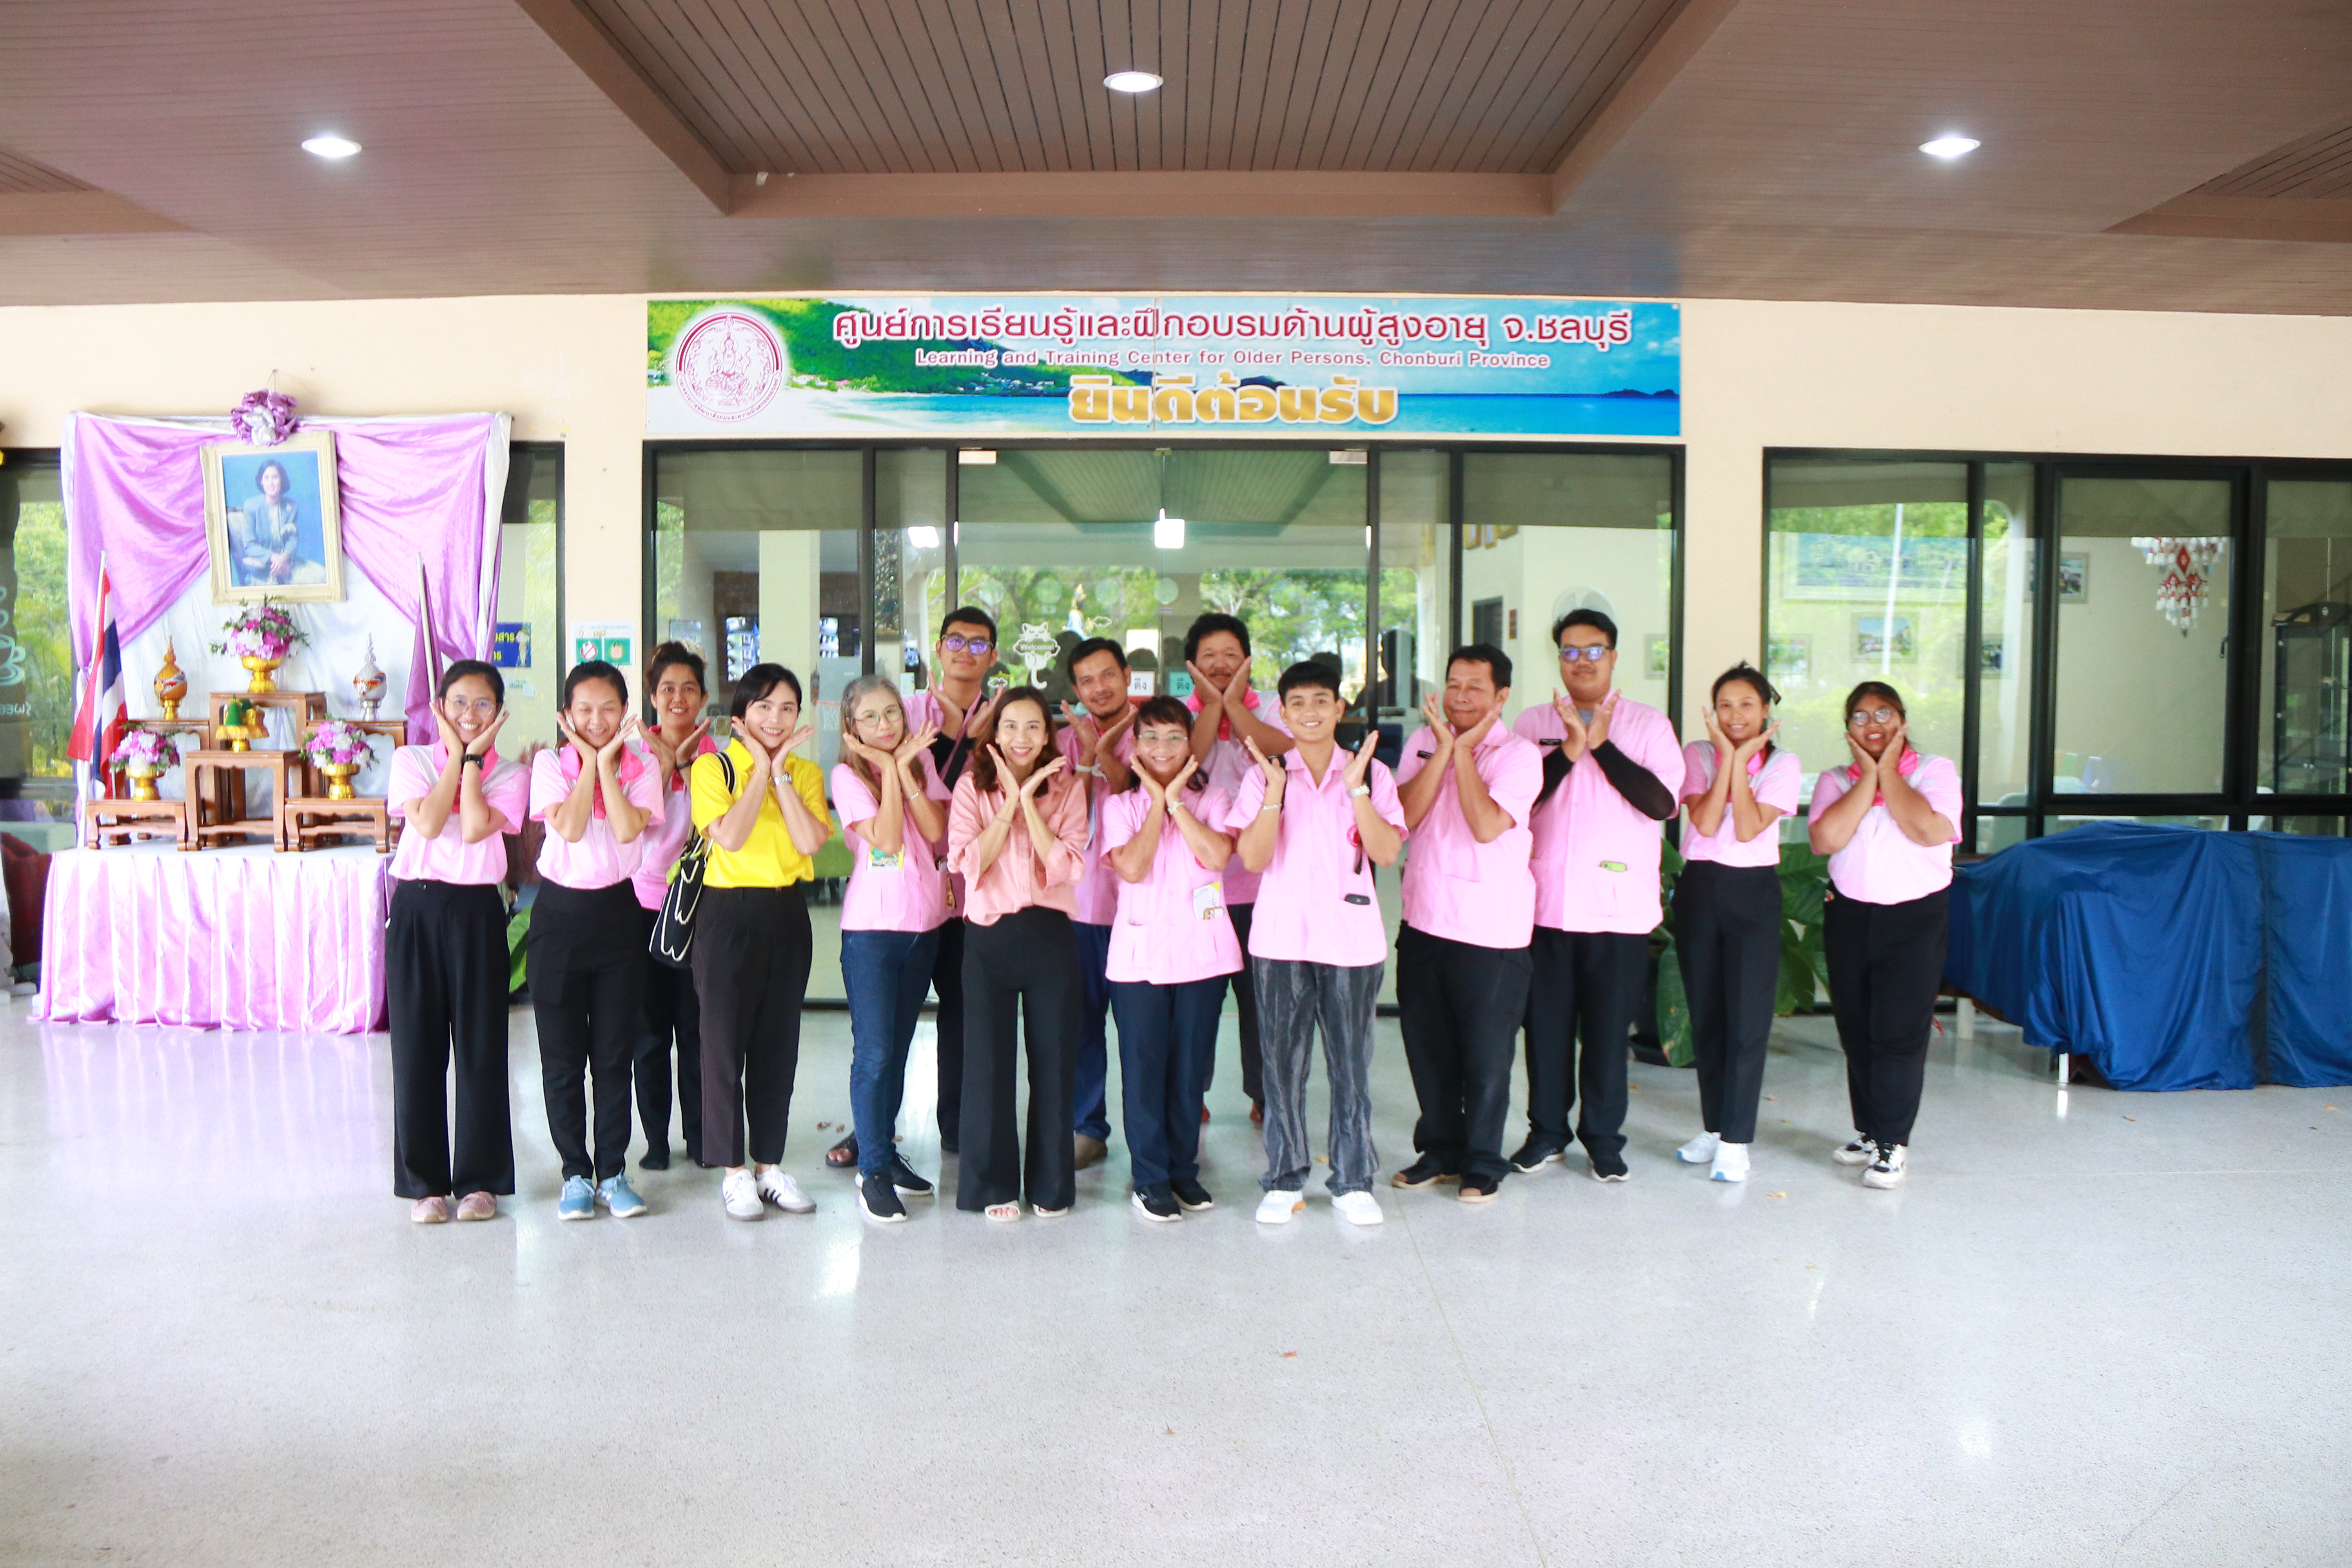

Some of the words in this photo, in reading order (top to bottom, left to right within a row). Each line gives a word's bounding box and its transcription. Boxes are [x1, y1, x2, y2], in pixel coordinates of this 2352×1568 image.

[837, 307, 1485, 347] ศูนย์การเรียนรู้และฝึกอบรมด้านผู้สูงอายุ
[1504, 312, 1628, 348] จ.ชลบุรี
[918, 349, 995, 365] Learning
[1004, 351, 1036, 363] and
[1046, 350, 1119, 365] Training
[1128, 351, 1190, 364] Center
[1200, 350, 1225, 363] for
[1234, 350, 1282, 364] Older
[1380, 352, 1461, 365] Chonburi
[1470, 353, 1548, 366] Province
[1070, 370, 1398, 423] ยินดีต้อนรับ
